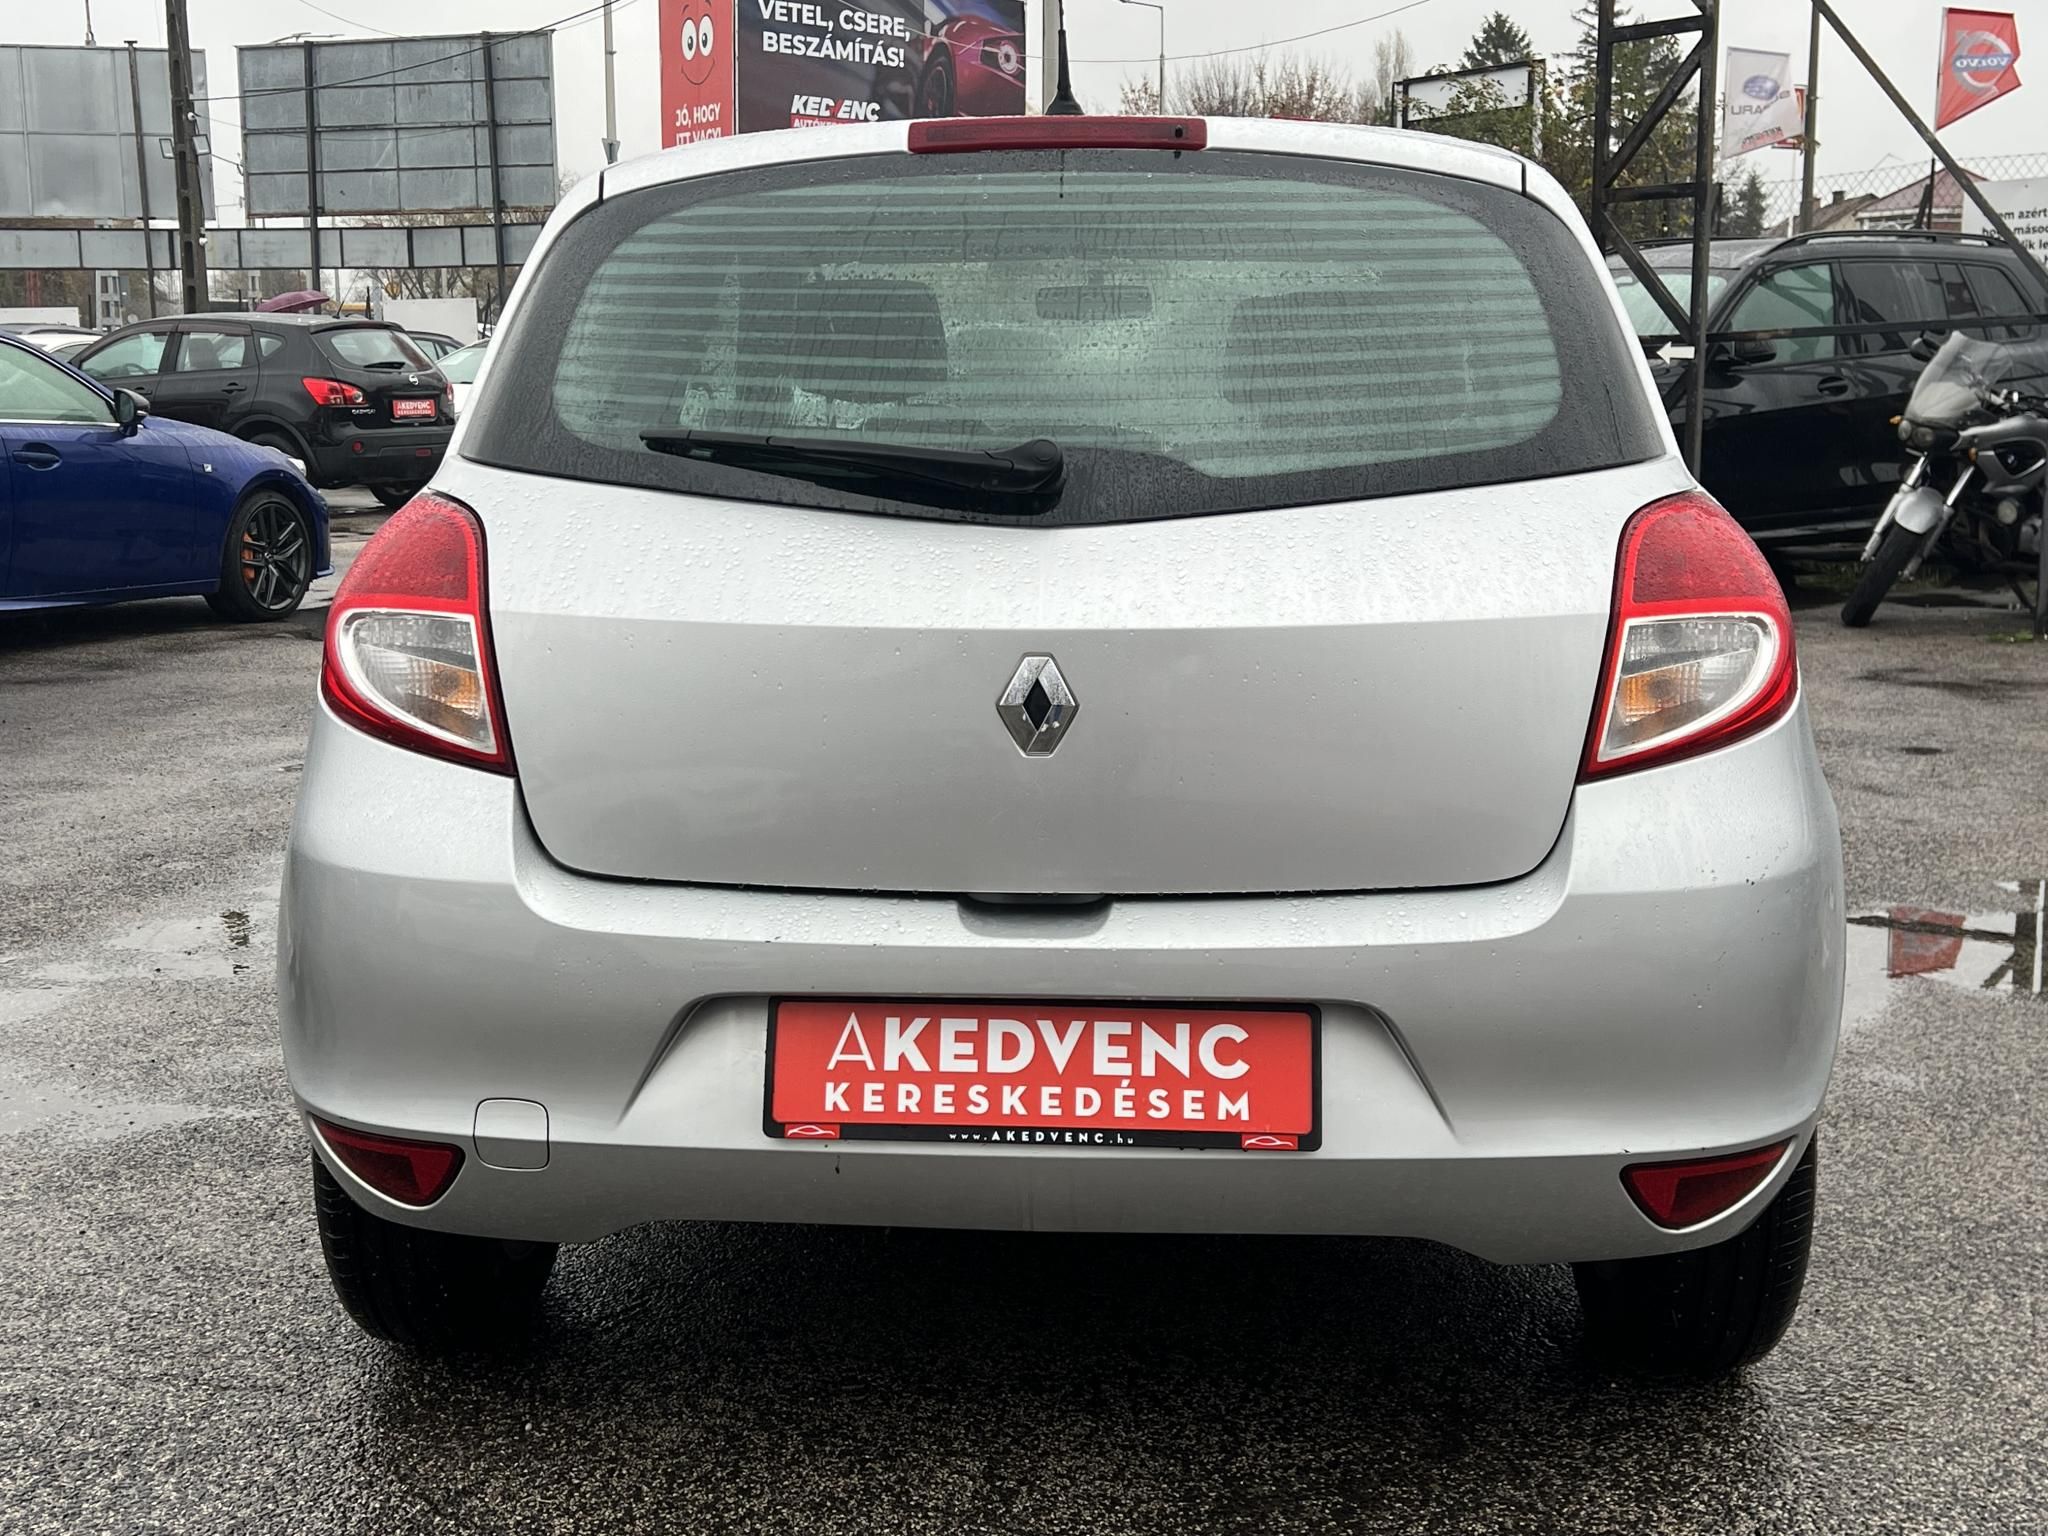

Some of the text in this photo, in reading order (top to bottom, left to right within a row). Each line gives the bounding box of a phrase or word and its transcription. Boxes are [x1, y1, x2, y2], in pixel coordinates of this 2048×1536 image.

[839, 9, 911, 42] CSERE,
[762, 31, 905, 68] BESZÁMÍTÁS!
[675, 102, 721, 128] JÓ, HOGY
[676, 131, 691, 146] ITT
[827, 1011, 1251, 1079] AKEDVENC
[823, 1079, 1250, 1121] KERESKEDÉSEM
[949, 1130, 1135, 1145] www.AKEDVENC.hu
